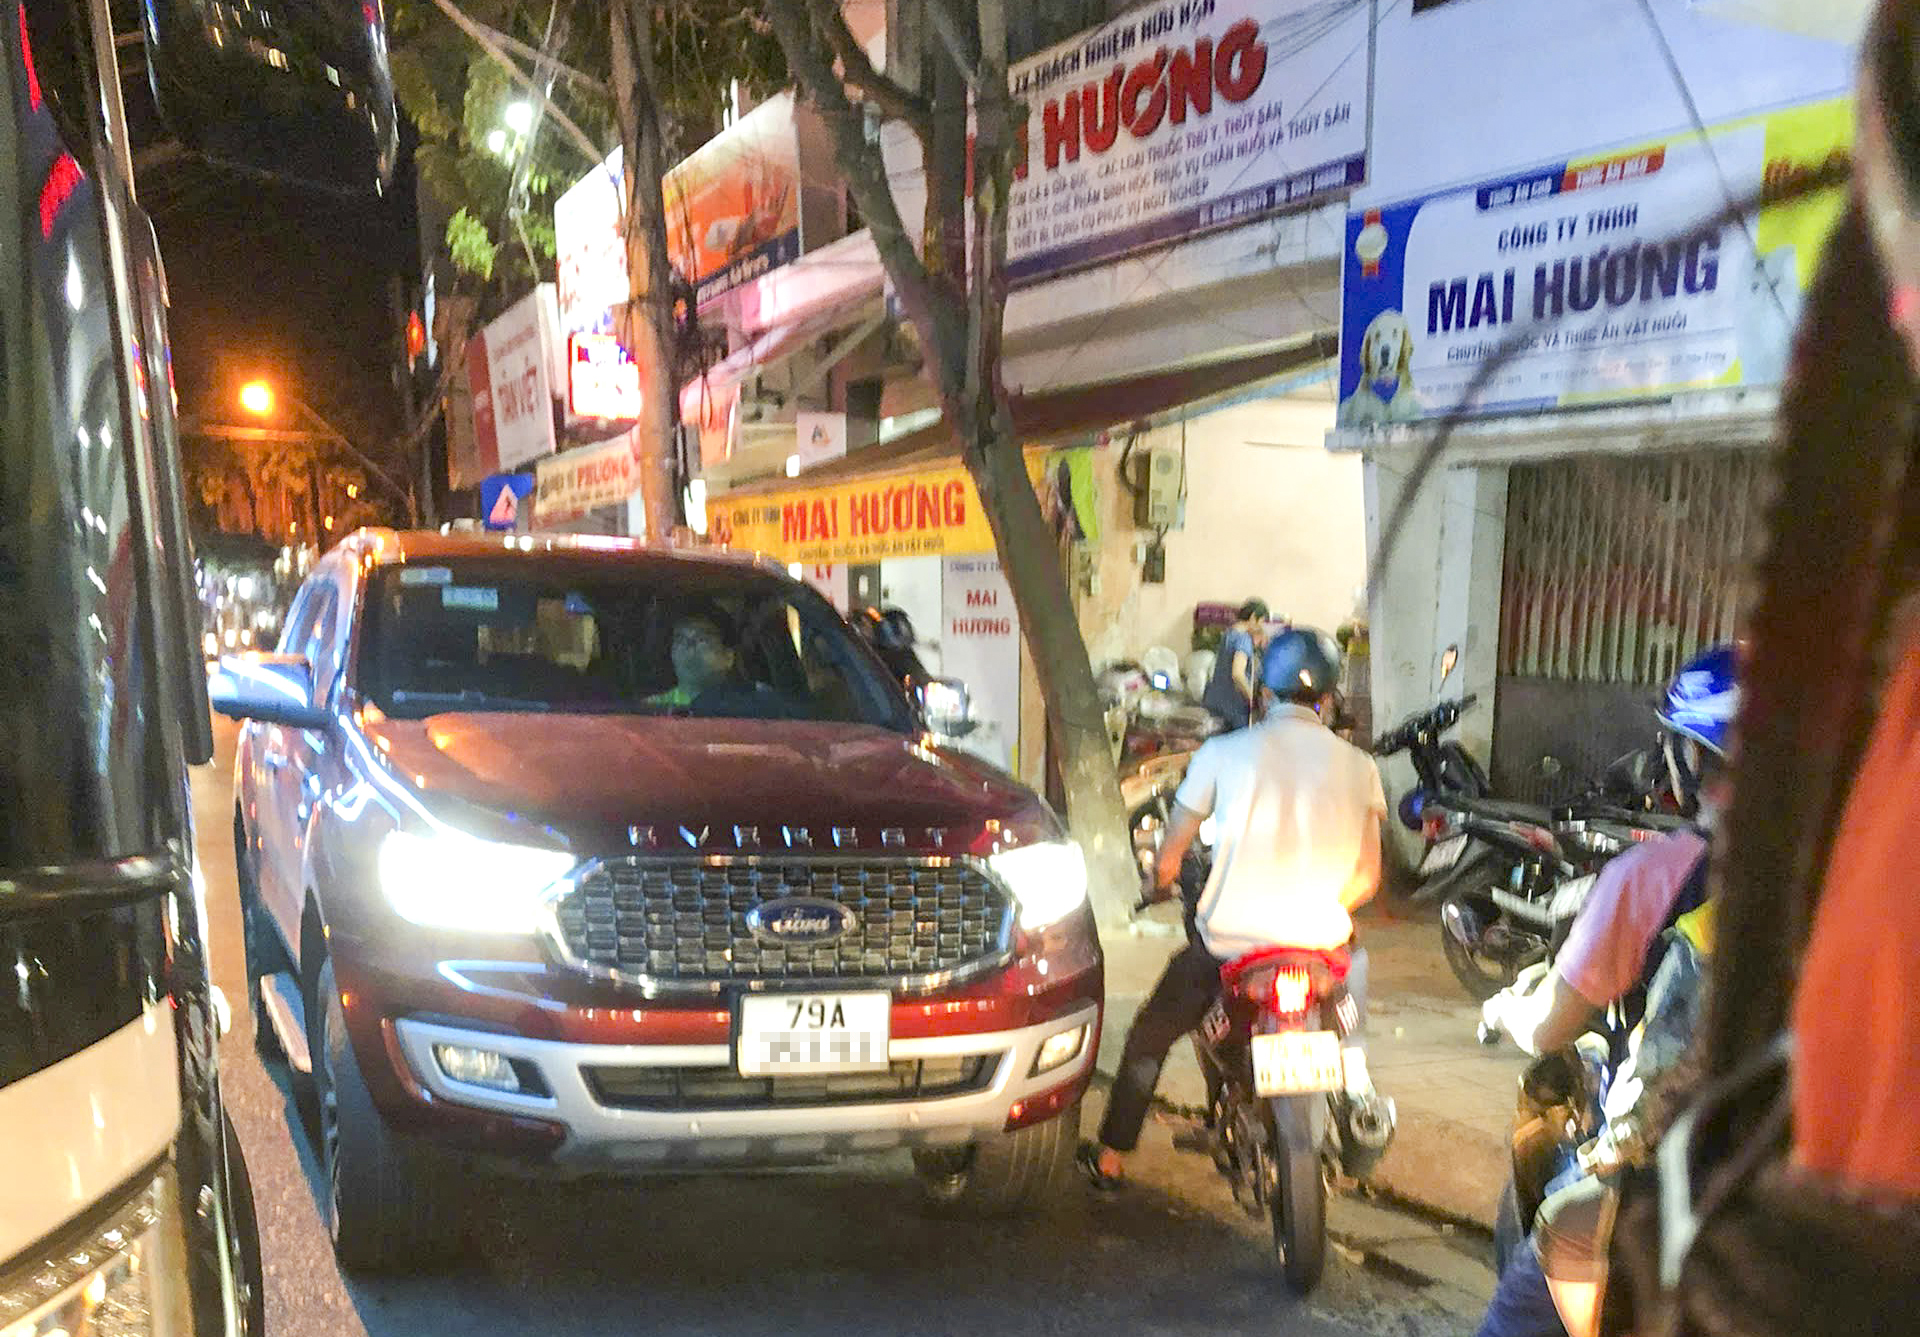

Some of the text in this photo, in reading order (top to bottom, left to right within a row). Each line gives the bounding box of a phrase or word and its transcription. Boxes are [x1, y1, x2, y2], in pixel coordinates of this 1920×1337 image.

[1043, 15, 1268, 172] HƯƠNG
[1498, 203, 1639, 252] CÔNG TY TNHH
[1427, 237, 1724, 338] MAI HƯƠNG
[782, 480, 966, 543] MAI HƯƠNG
[966, 589, 997, 607] MAI
[786, 999, 847, 1030] 79A
